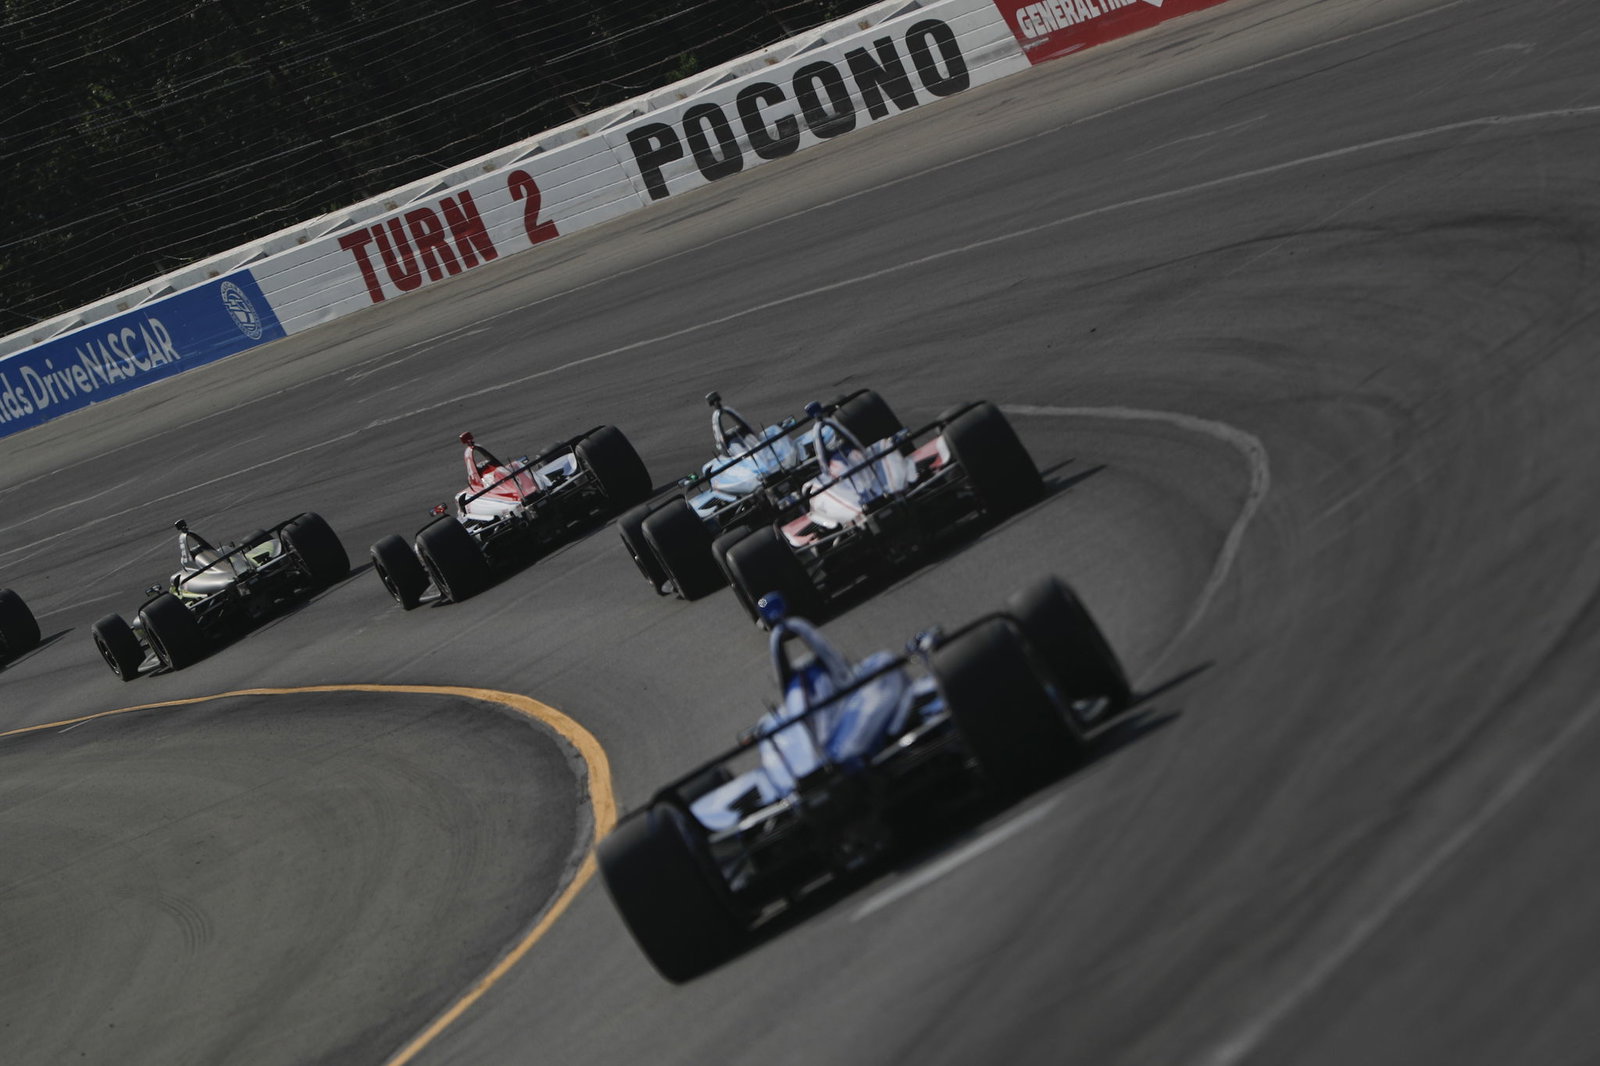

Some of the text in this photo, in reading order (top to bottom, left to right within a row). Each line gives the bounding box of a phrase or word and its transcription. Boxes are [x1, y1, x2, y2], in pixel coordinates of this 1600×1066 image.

[626, 18, 970, 201] POCONO
[337, 169, 560, 304] TURN 2
